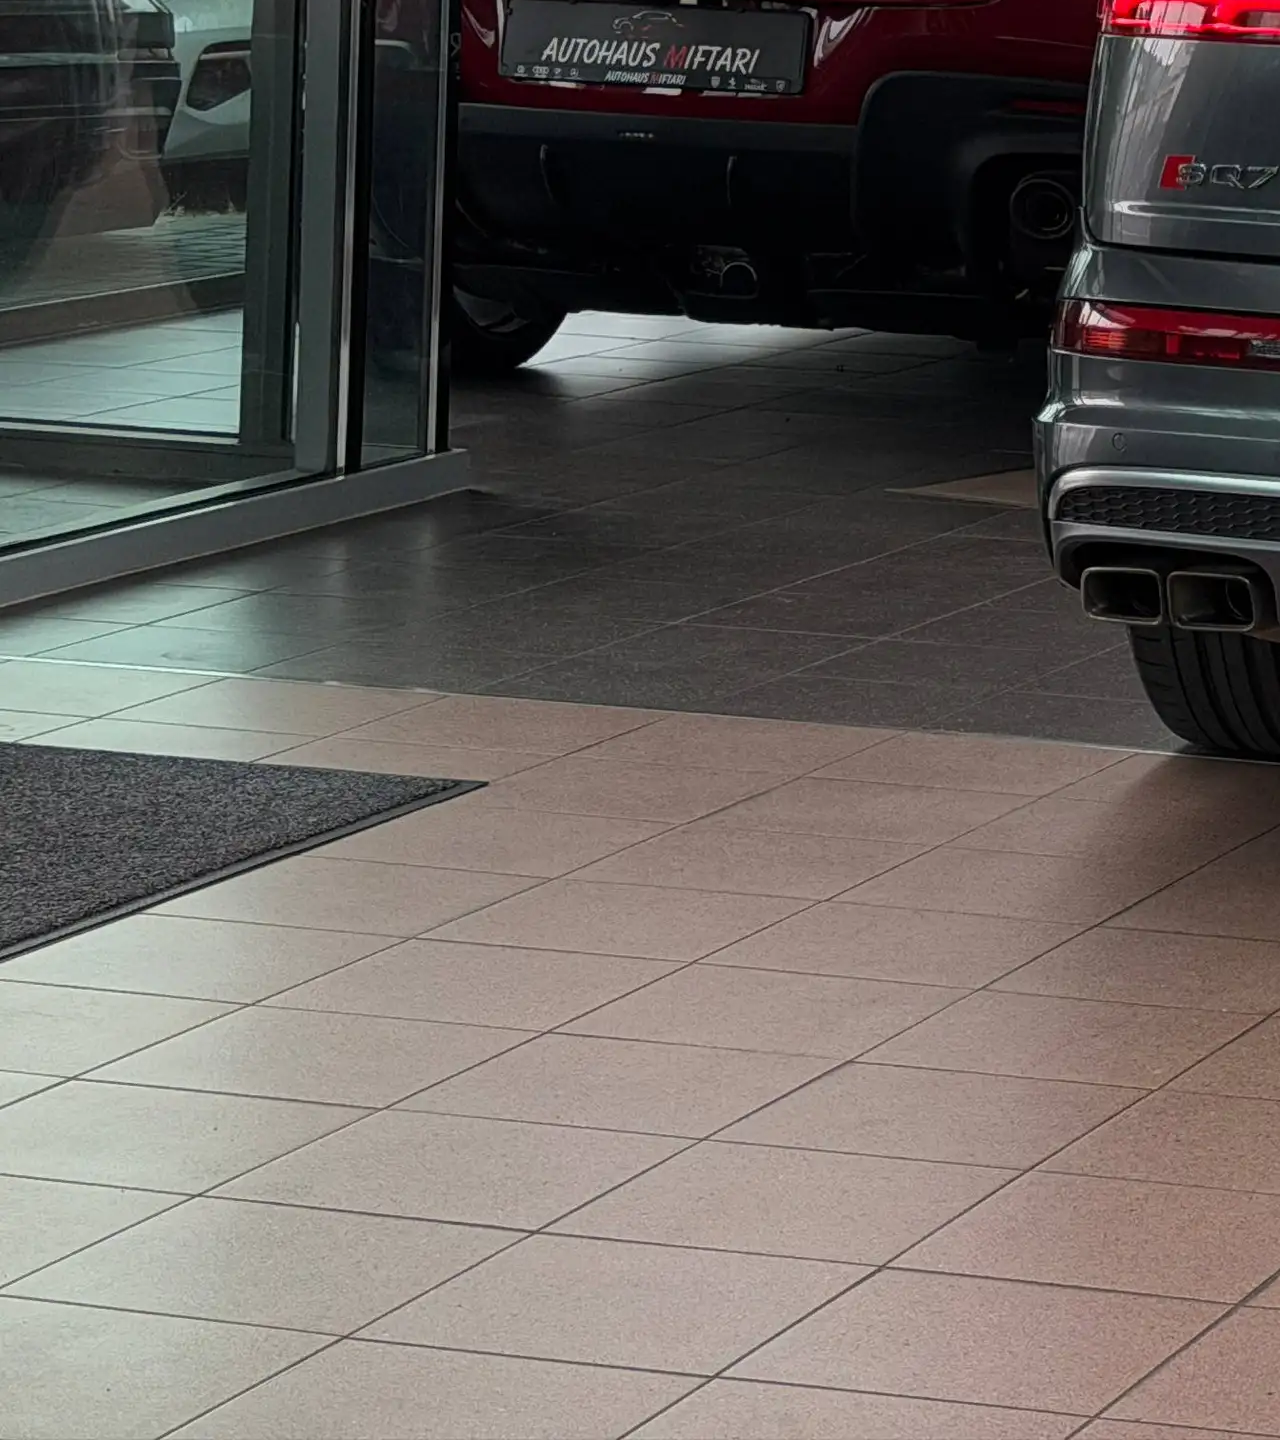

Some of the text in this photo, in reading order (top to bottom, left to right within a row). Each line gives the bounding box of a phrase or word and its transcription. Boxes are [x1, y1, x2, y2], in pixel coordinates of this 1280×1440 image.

[540, 36, 761, 76] AUTOHAUS MIFTARI
[604, 70, 687, 86] AUTOHAUS MIFTARI
[1175, 162, 1280, 190] SQ7
